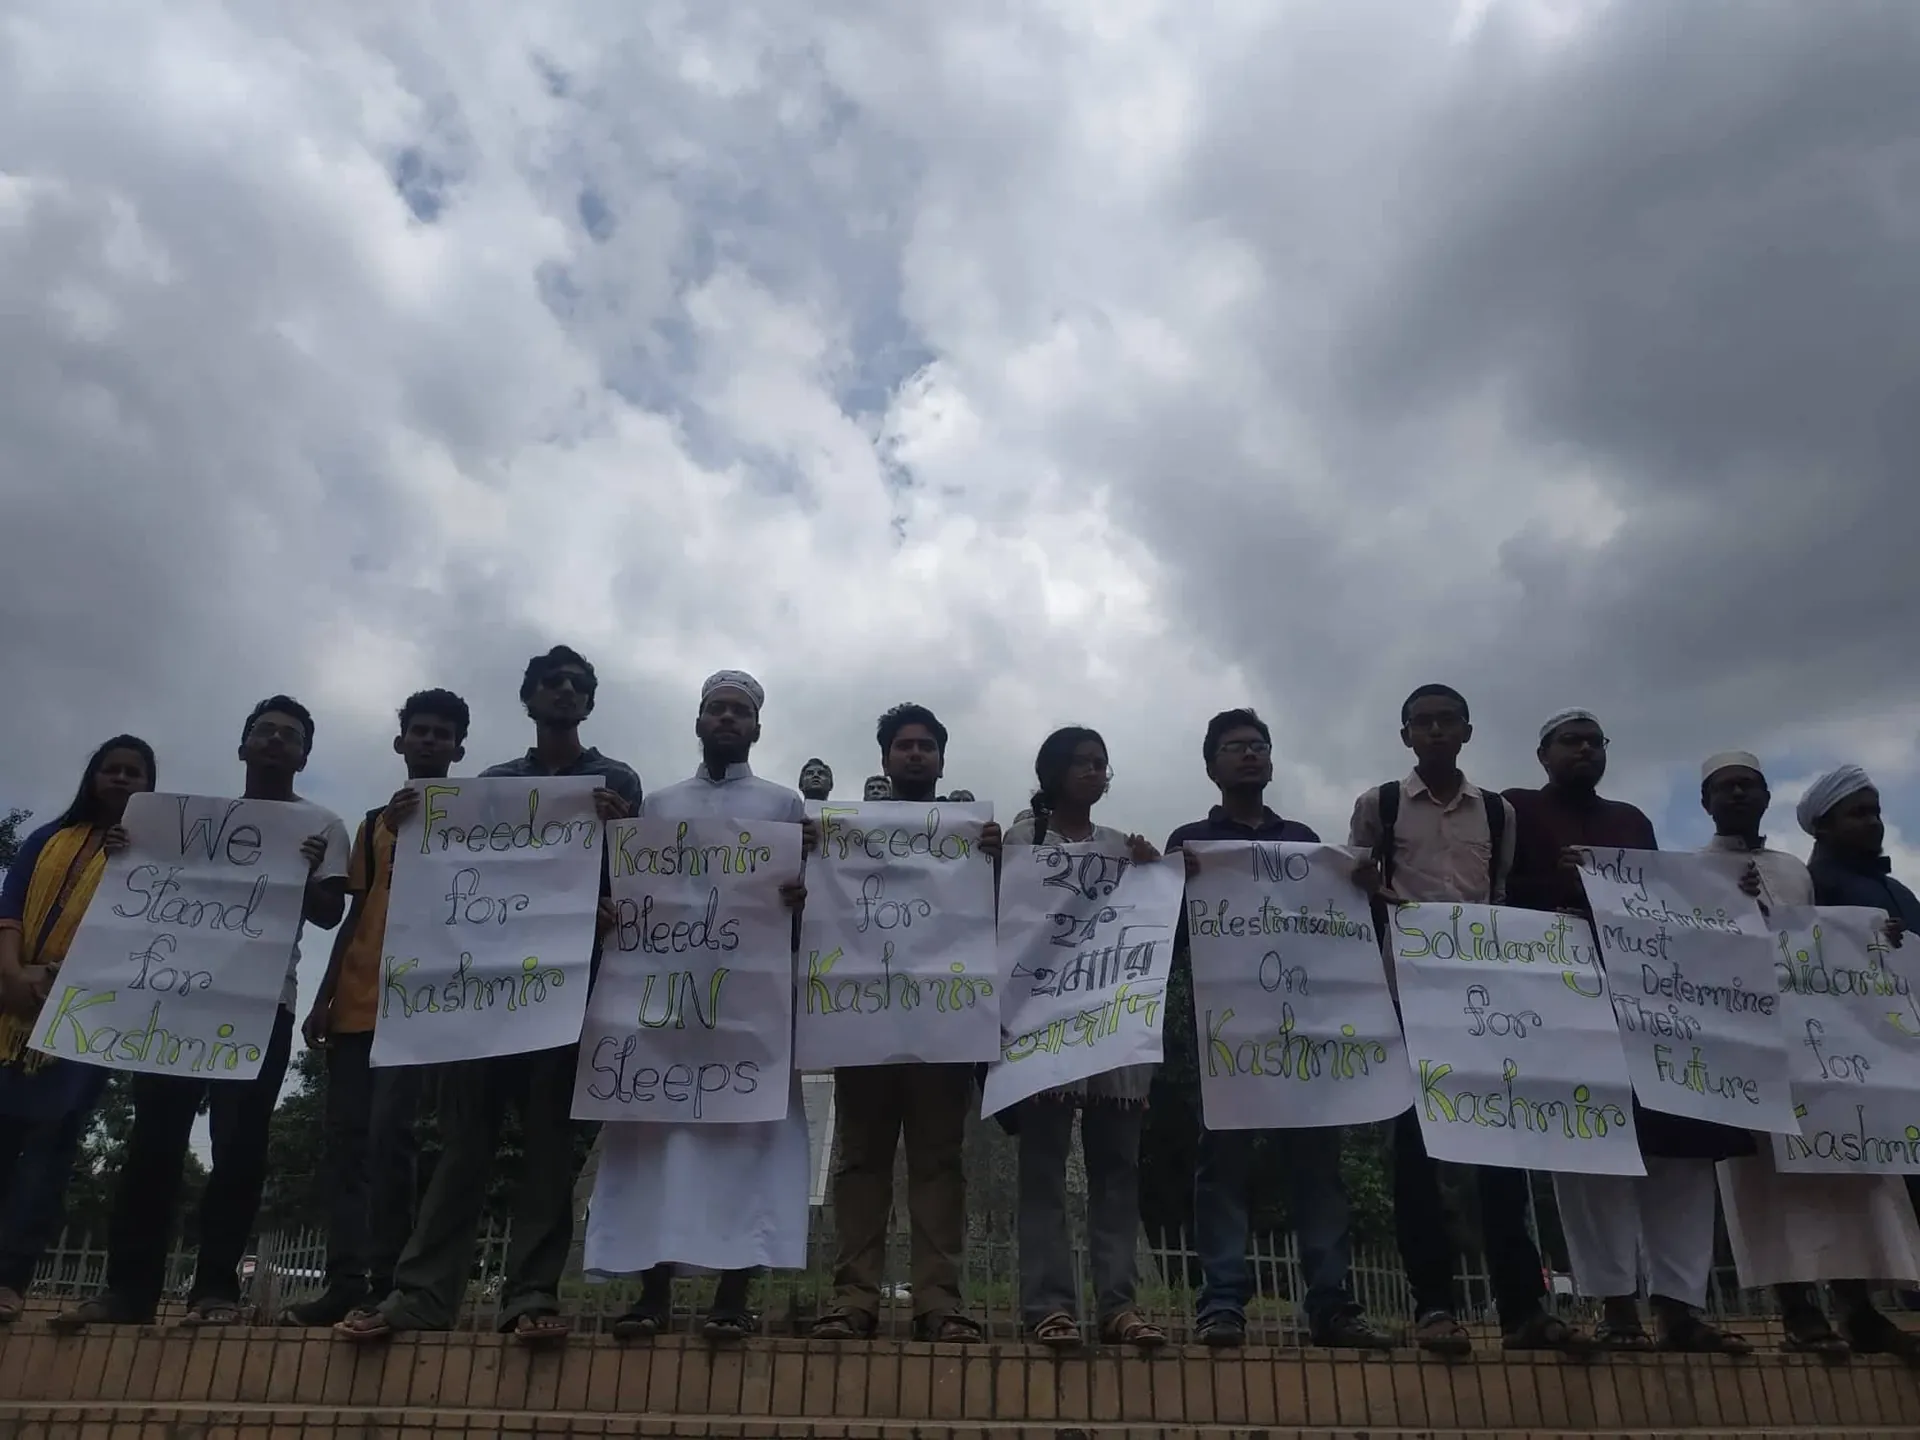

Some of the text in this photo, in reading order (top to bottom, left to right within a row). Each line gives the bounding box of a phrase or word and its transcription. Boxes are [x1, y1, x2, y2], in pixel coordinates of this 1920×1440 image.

[177, 796, 262, 866] We
[421, 785, 596, 854] Freedom
[613, 822, 771, 877] Kashmir
[112, 865, 268, 938] Stand
[445, 868, 530, 925] for
[616, 886, 740, 954] Bleeds
[856, 873, 931, 933] for
[1622, 896, 1742, 936] Kashmiris
[128, 934, 212, 997] for
[1259, 950, 1308, 996] On
[1395, 901, 1602, 998] Solidarity
[1603, 924, 1673, 960] Must
[382, 952, 565, 1018] Kashmir
[638, 968, 730, 1029] UN
[807, 941, 993, 1015] Kashmir
[1641, 962, 1775, 1016] Determine
[43, 986, 261, 1071] Kashmir
[1206, 1002, 1386, 1081] Kashmir
[1464, 984, 1542, 1038] for
[1612, 992, 1701, 1040] Their
[587, 1035, 759, 1119] Sleeps
[1654, 1044, 1760, 1105] Future
[1804, 1018, 1871, 1084] for
[1419, 1058, 1626, 1139] Kashmir
